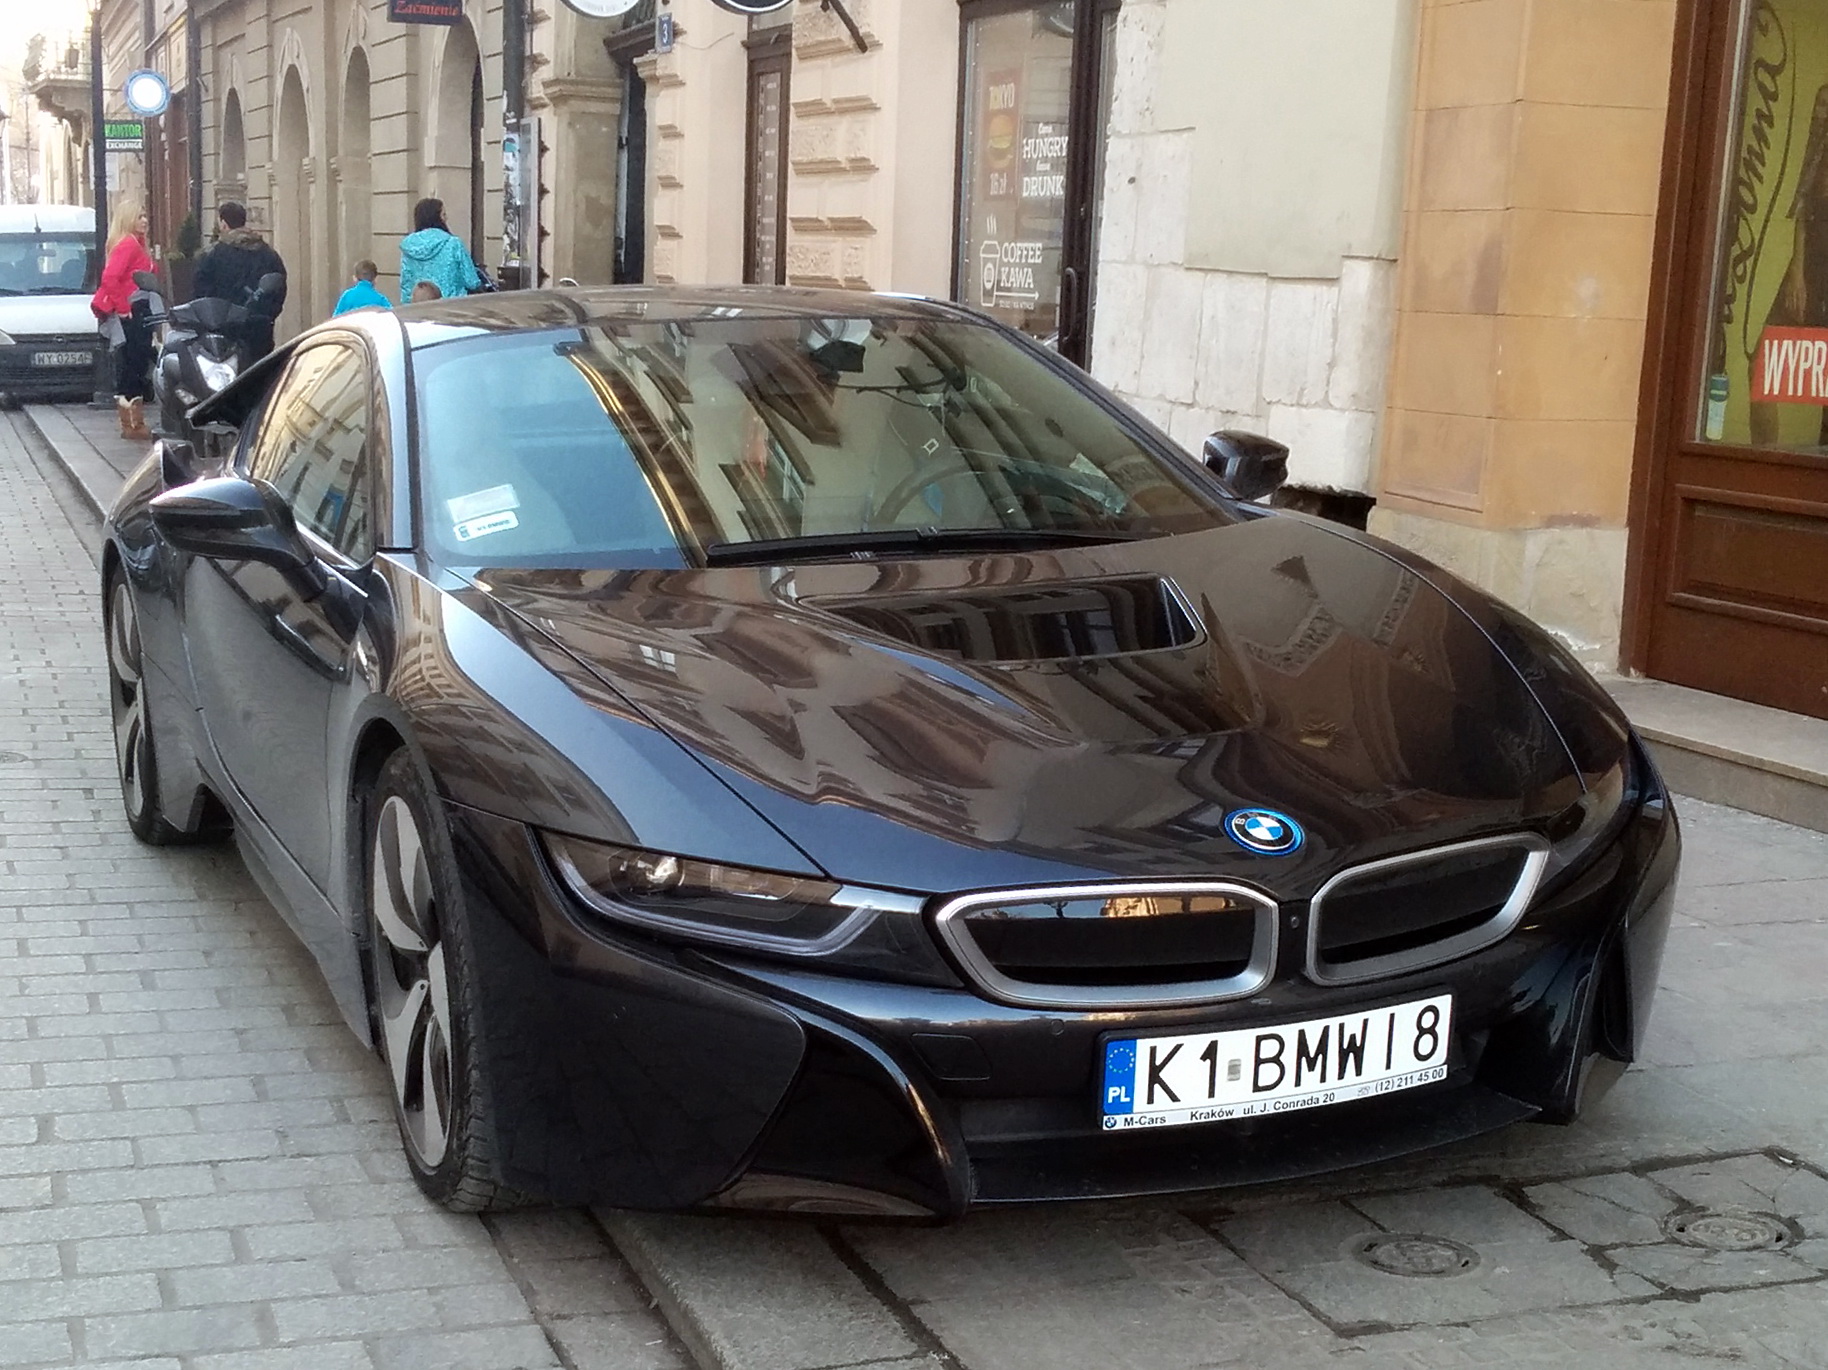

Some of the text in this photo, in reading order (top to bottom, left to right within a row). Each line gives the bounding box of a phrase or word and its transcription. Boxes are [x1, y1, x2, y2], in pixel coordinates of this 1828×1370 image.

[104, 123, 142, 138] KANTOR
[1022, 136, 1069, 159] HUNGRY
[1022, 174, 1065, 197] DRUNK
[1001, 242, 1043, 263] COFFEE
[1000, 267, 1034, 288] KAWA
[1763, 339, 1828, 398] WYPR
[1146, 1039, 1219, 1105] K1
[1107, 1086, 1131, 1104] PL
[1123, 1067, 1446, 1127] M-Cars Kraków ul. J. Conrada 20 (12) 211 45 00
